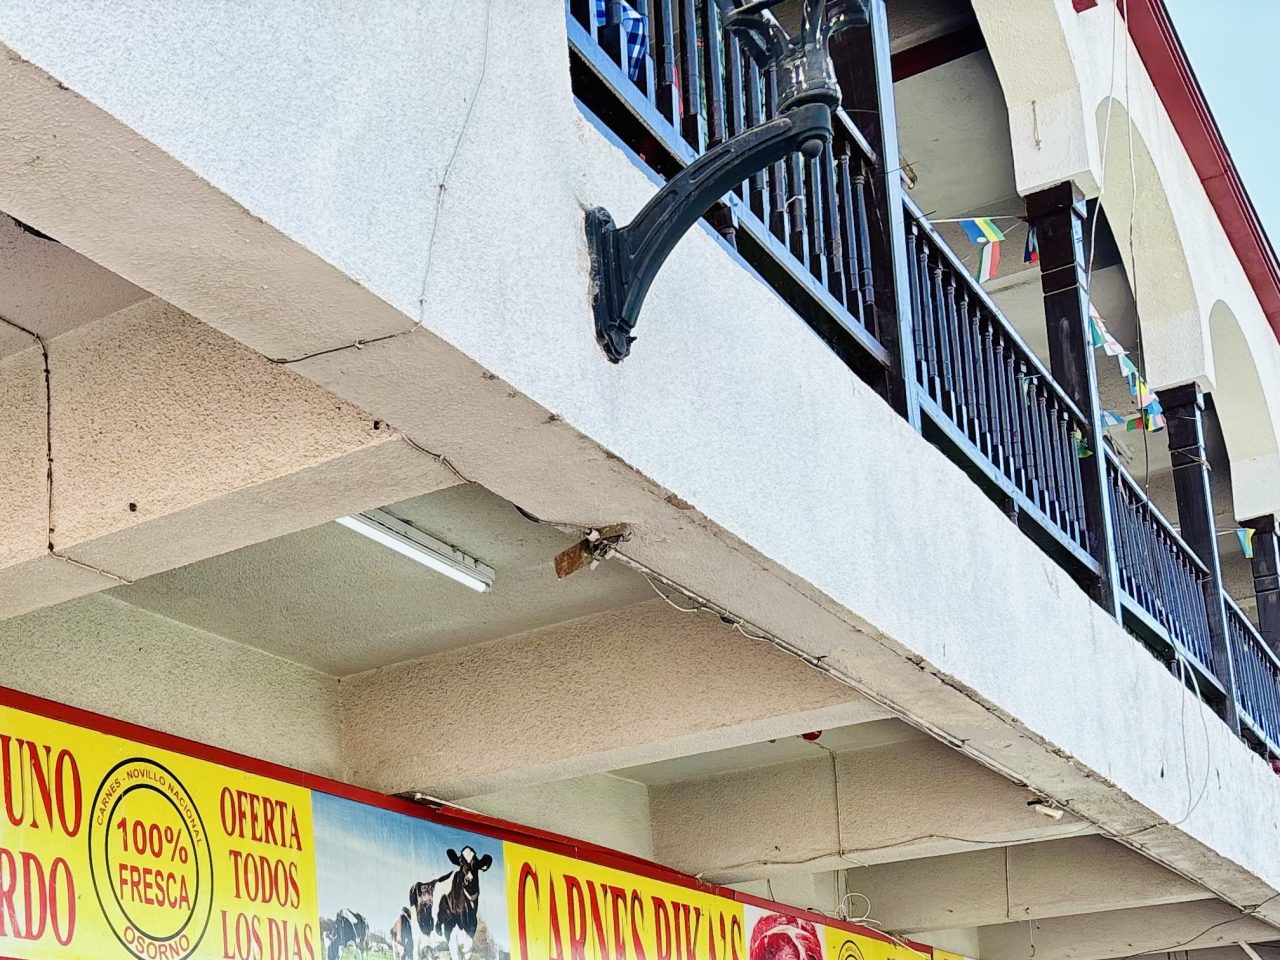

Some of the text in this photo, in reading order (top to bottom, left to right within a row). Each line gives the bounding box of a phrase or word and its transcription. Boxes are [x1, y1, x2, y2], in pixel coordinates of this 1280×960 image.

[96, 767, 203, 848] CARNES NOVILLO NACIONAL
[219, 785, 303, 853] OFERTA
[116, 816, 190, 866] 100%
[118, 862, 192, 912] FRESCA
[228, 849, 302, 910] TODOS
